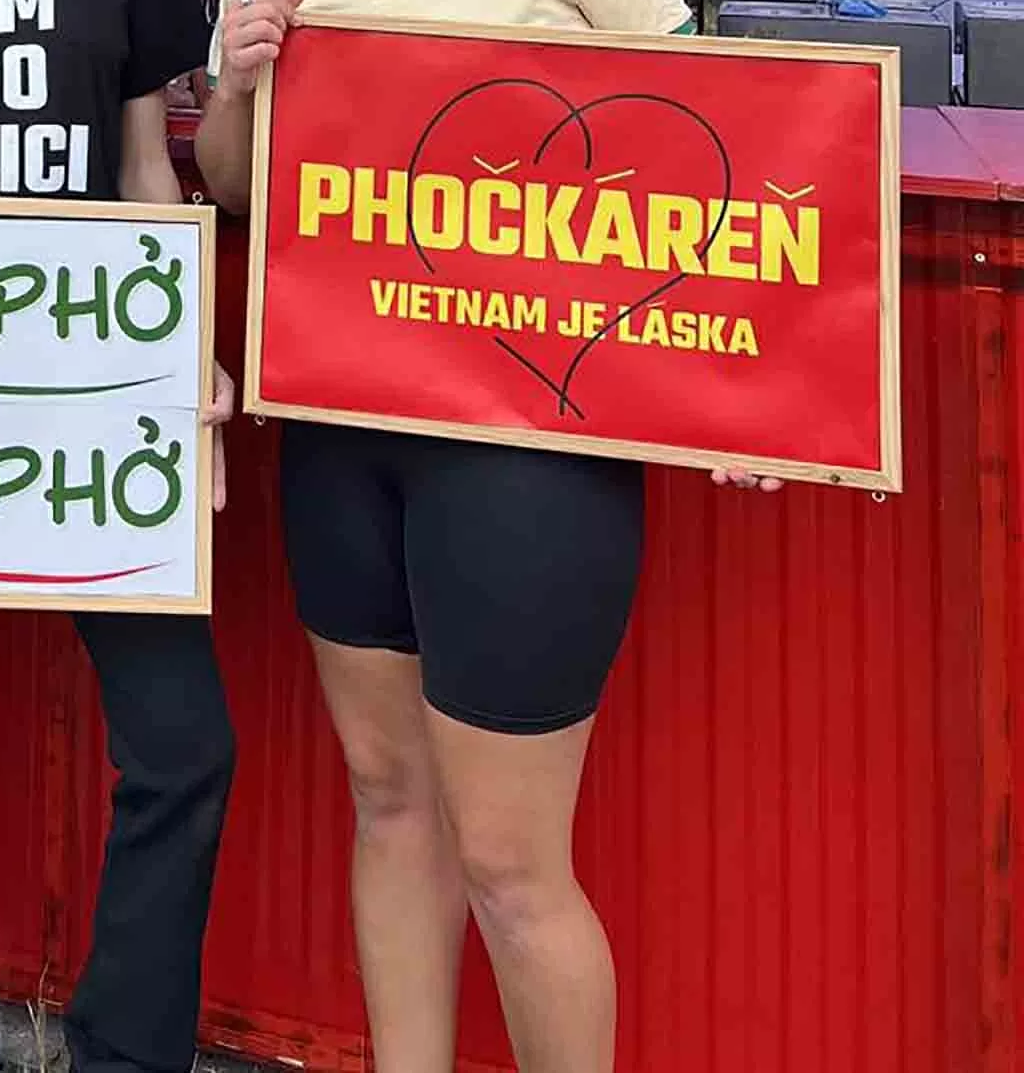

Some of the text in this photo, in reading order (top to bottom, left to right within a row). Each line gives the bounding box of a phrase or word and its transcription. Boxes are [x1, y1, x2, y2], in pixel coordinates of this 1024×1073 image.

[297, 154, 822, 287] PHOČKÁREŇ
[368, 278, 761, 357] VIETNAM JE LÁSKA
